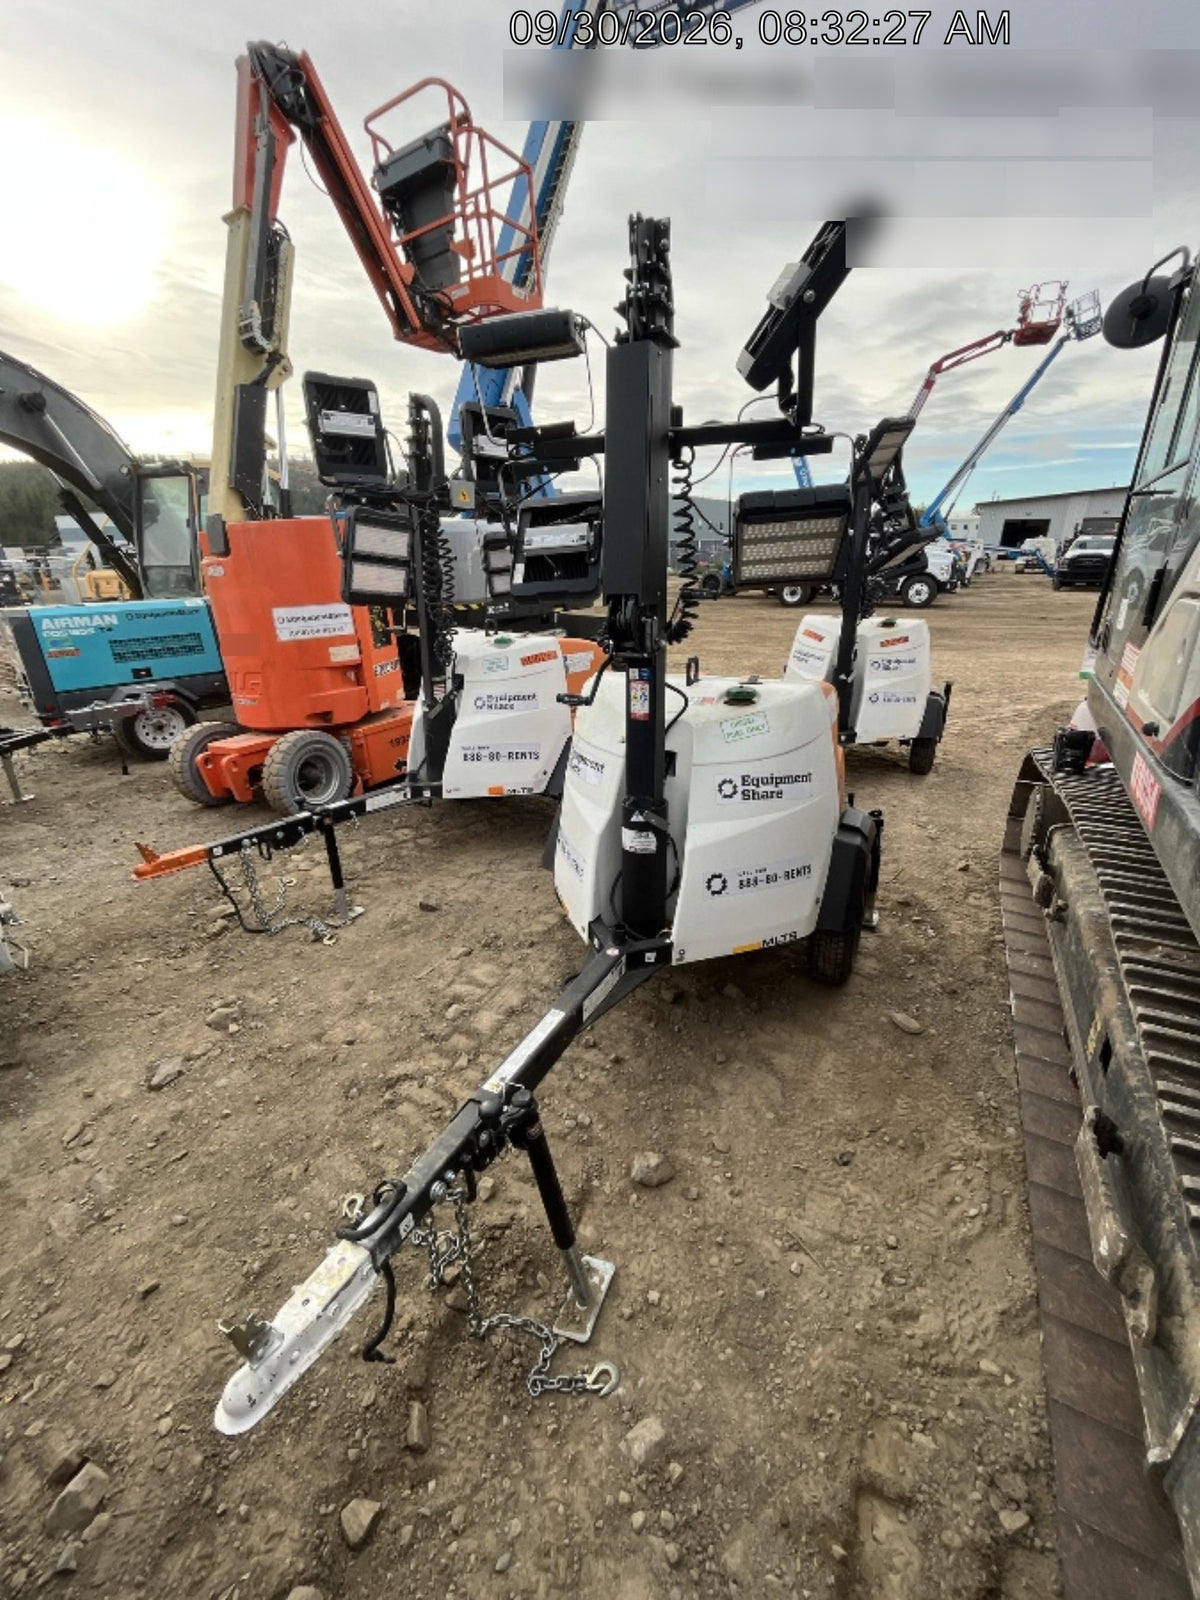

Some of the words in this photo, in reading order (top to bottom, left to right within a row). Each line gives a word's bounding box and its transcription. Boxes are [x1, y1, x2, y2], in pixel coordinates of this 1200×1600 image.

[42, 614, 118, 630] AIRMAN
[741, 772, 812, 788] Equipment
[741, 788, 783, 801] Share
[739, 864, 812, 889] 888-80-RENTS
